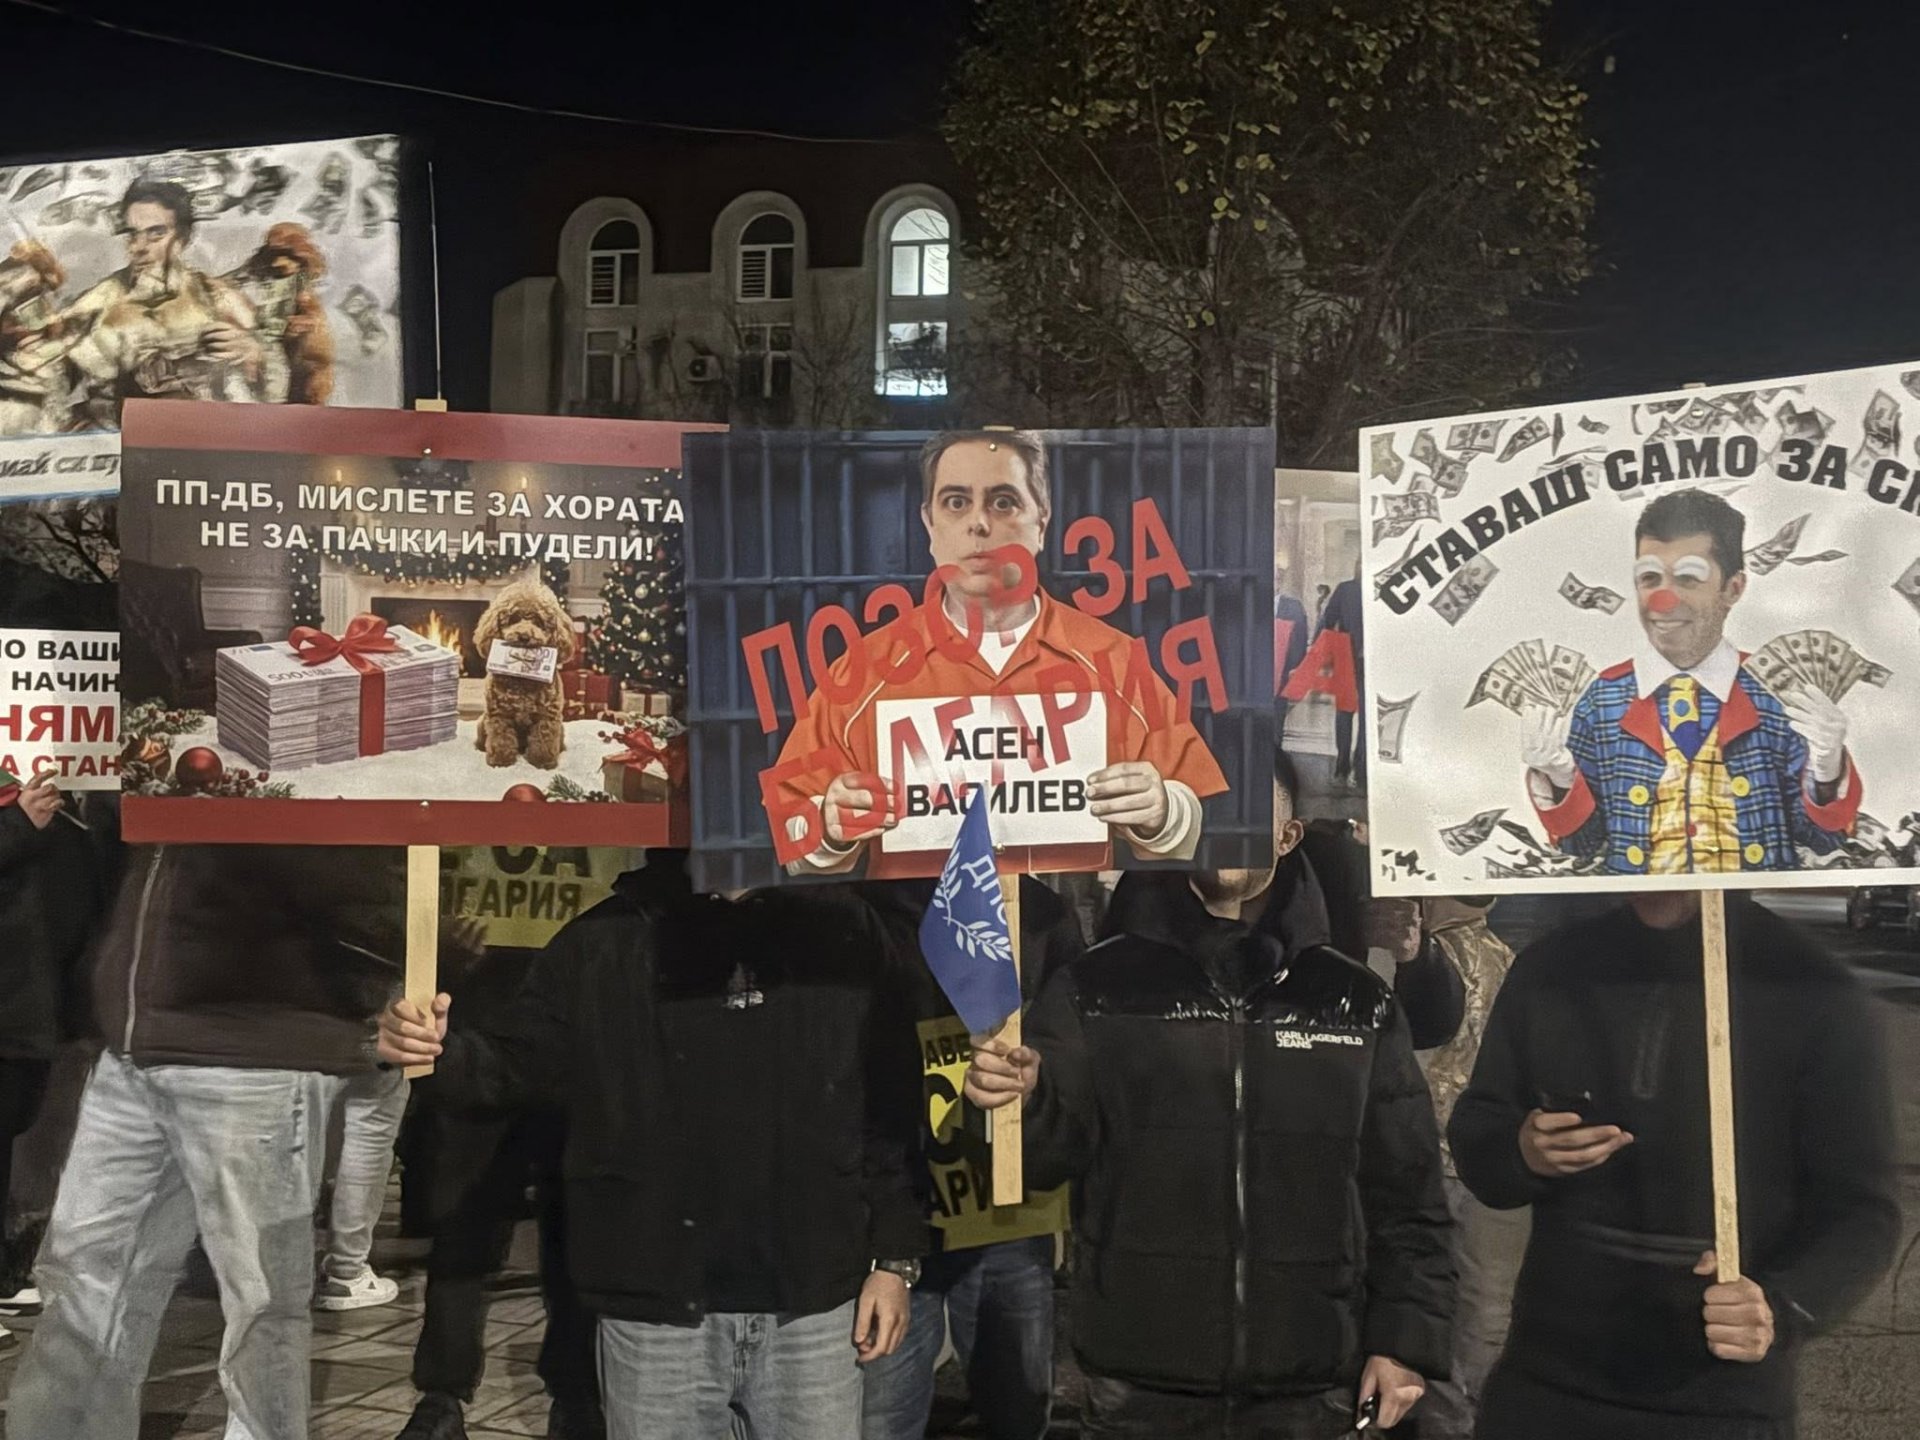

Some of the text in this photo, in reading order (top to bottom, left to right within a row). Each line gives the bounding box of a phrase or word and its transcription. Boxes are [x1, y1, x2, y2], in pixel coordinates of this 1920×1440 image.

[155, 478, 685, 525] ПП-ДБ, МИСЛЕТЕ ЗА ХОРАТА
[200, 521, 655, 563] НЕ ЗА ПАЧКИ И ПУДЕЛИ!
[1378, 461, 1591, 616] СТАВАШ
[1603, 434, 1759, 493] САМО
[1777, 438, 1849, 491] ЗА
[741, 498, 1193, 734] ПОЗОР ЗА
[0, 638, 27, 660] О
[944, 725, 1045, 761] АСЕН
[906, 779, 1087, 818] ВАСИЛЕВ
[1275, 1030, 1364, 1046] KARL LAGERFELD
[1276, 1039, 1313, 1050] JEANS
